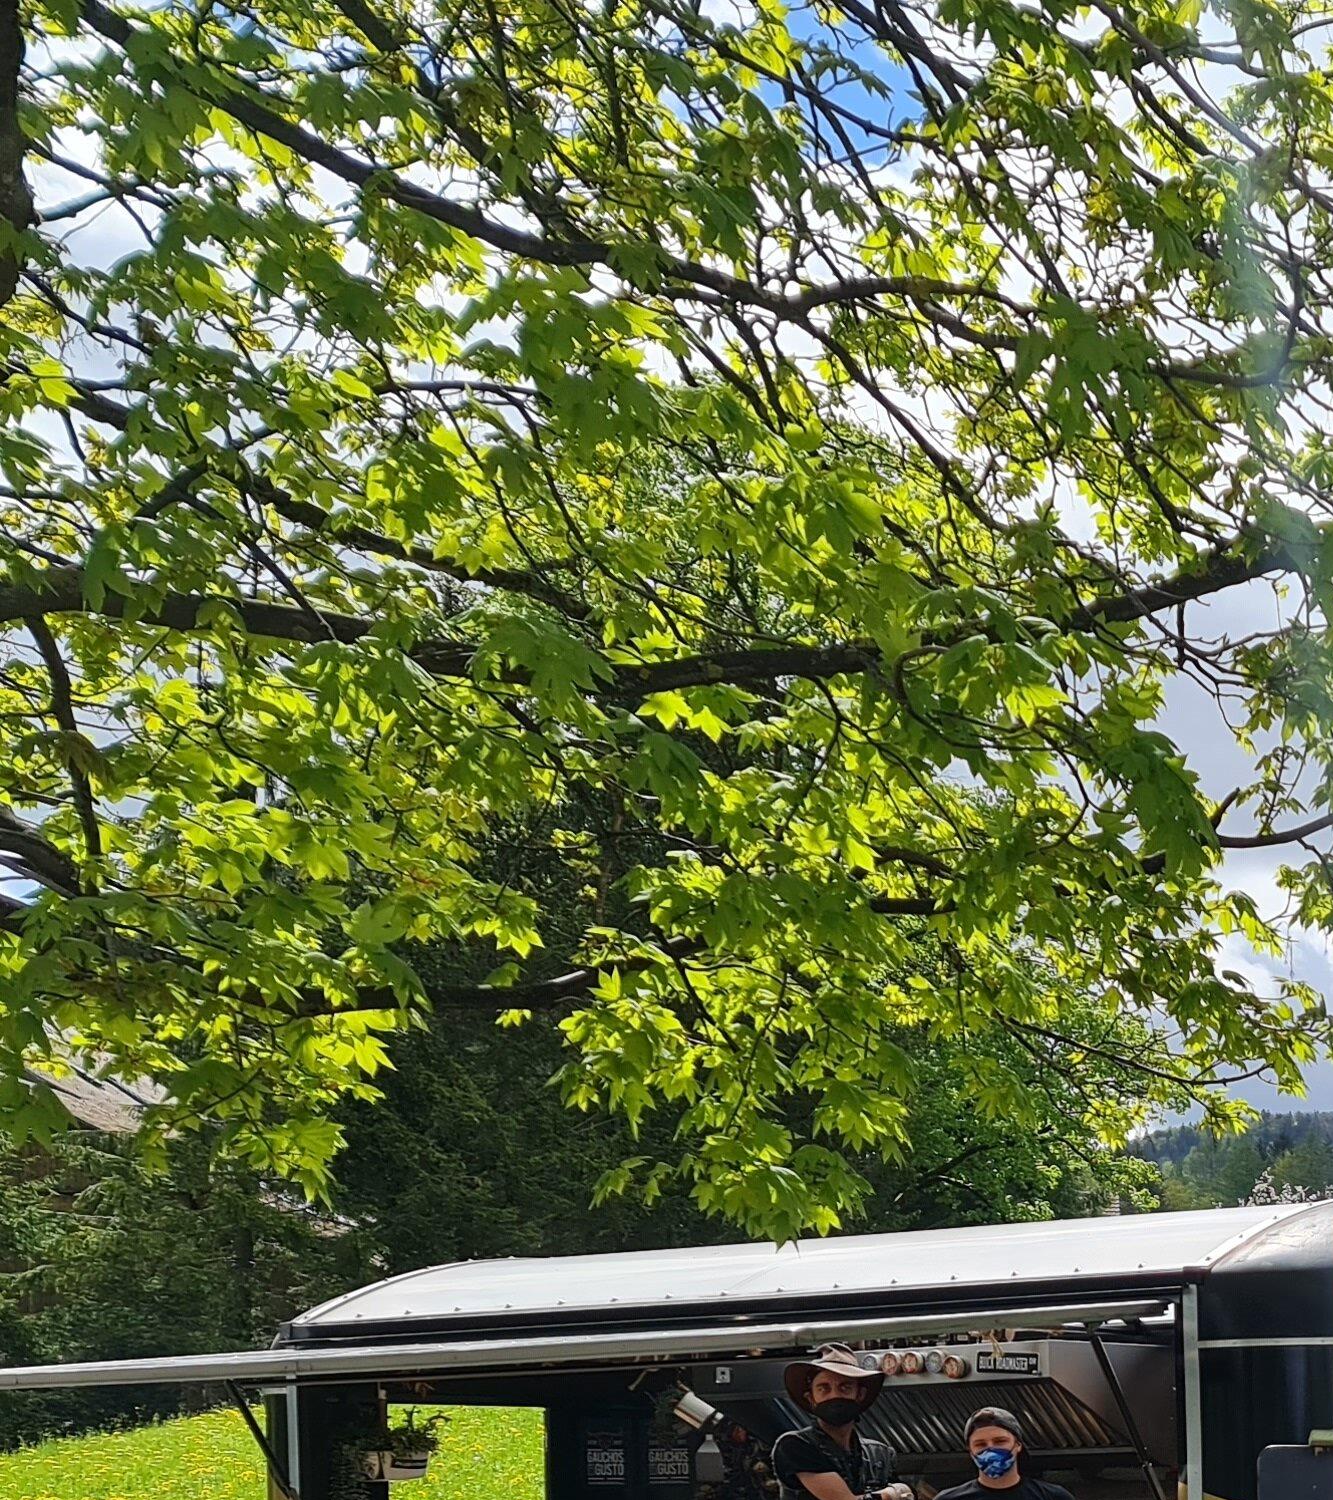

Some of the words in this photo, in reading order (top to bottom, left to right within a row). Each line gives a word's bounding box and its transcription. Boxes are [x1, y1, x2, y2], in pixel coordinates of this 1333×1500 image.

[586, 1451, 625, 1463] GAUCHOS
[648, 1451, 689, 1463] GAUCHOS
[594, 1463, 625, 1476] GUSTO
[657, 1462, 689, 1475] GUSTO
